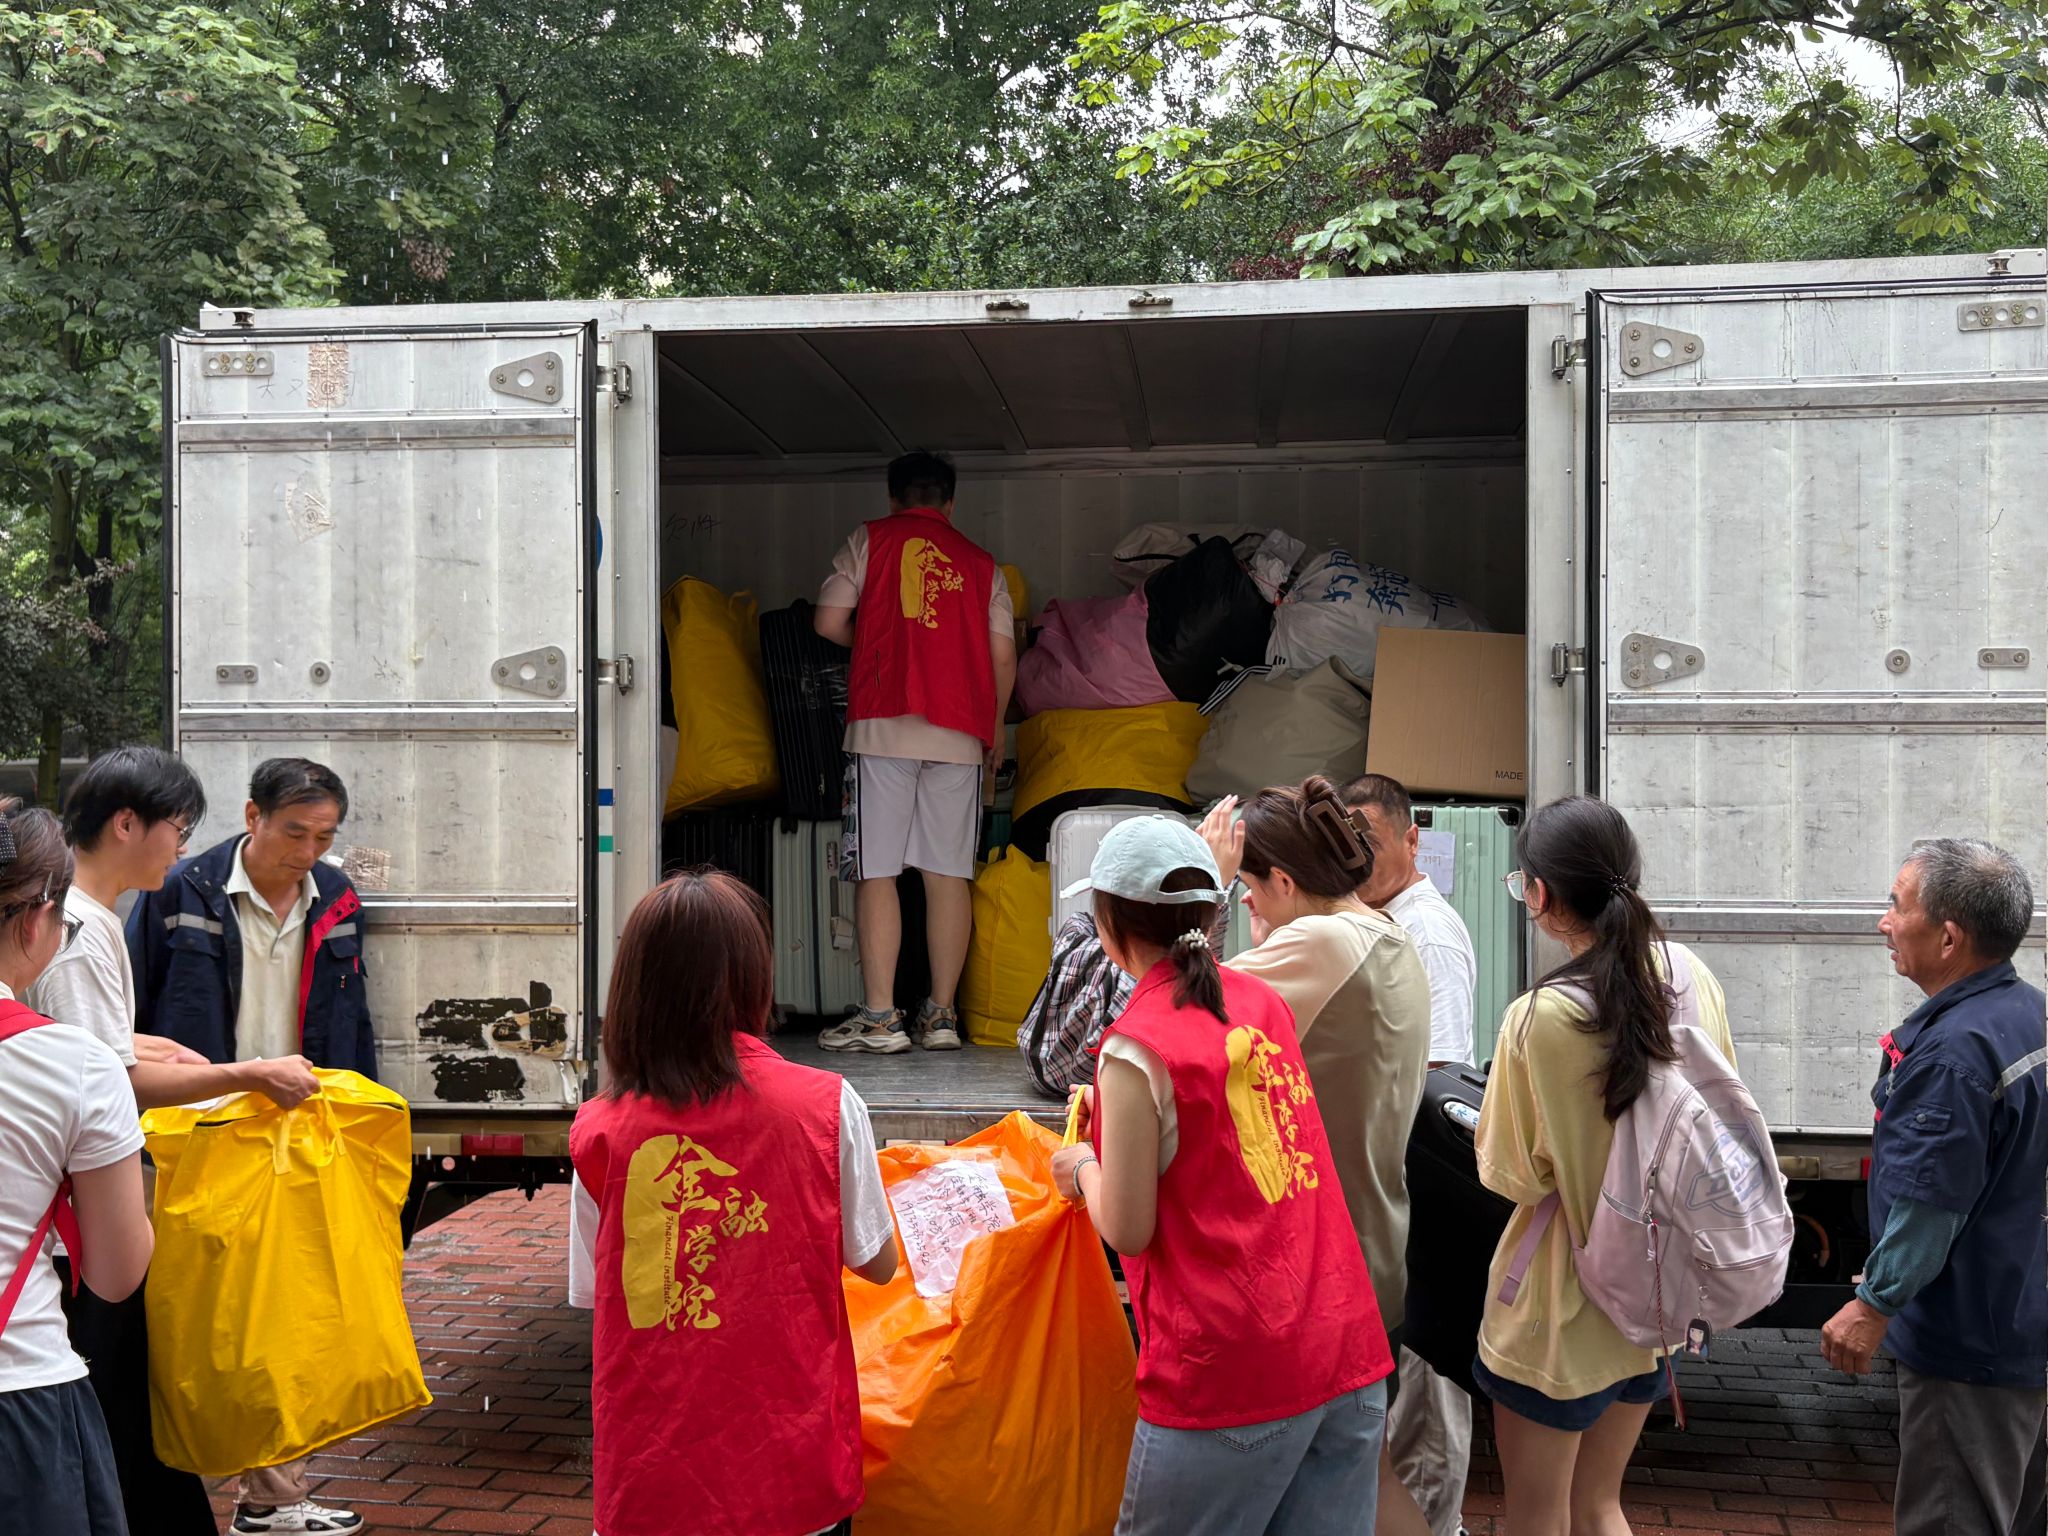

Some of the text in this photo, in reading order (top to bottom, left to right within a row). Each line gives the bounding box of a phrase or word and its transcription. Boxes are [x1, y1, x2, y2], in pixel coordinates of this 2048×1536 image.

[915, 539, 964, 629] 金融学院
[1495, 770, 1523, 781] MADE
[1244, 1024, 1319, 1200] 金融学院
[654, 1134, 769, 1332] 金融学院
[665, 1215, 674, 1261] Financial
